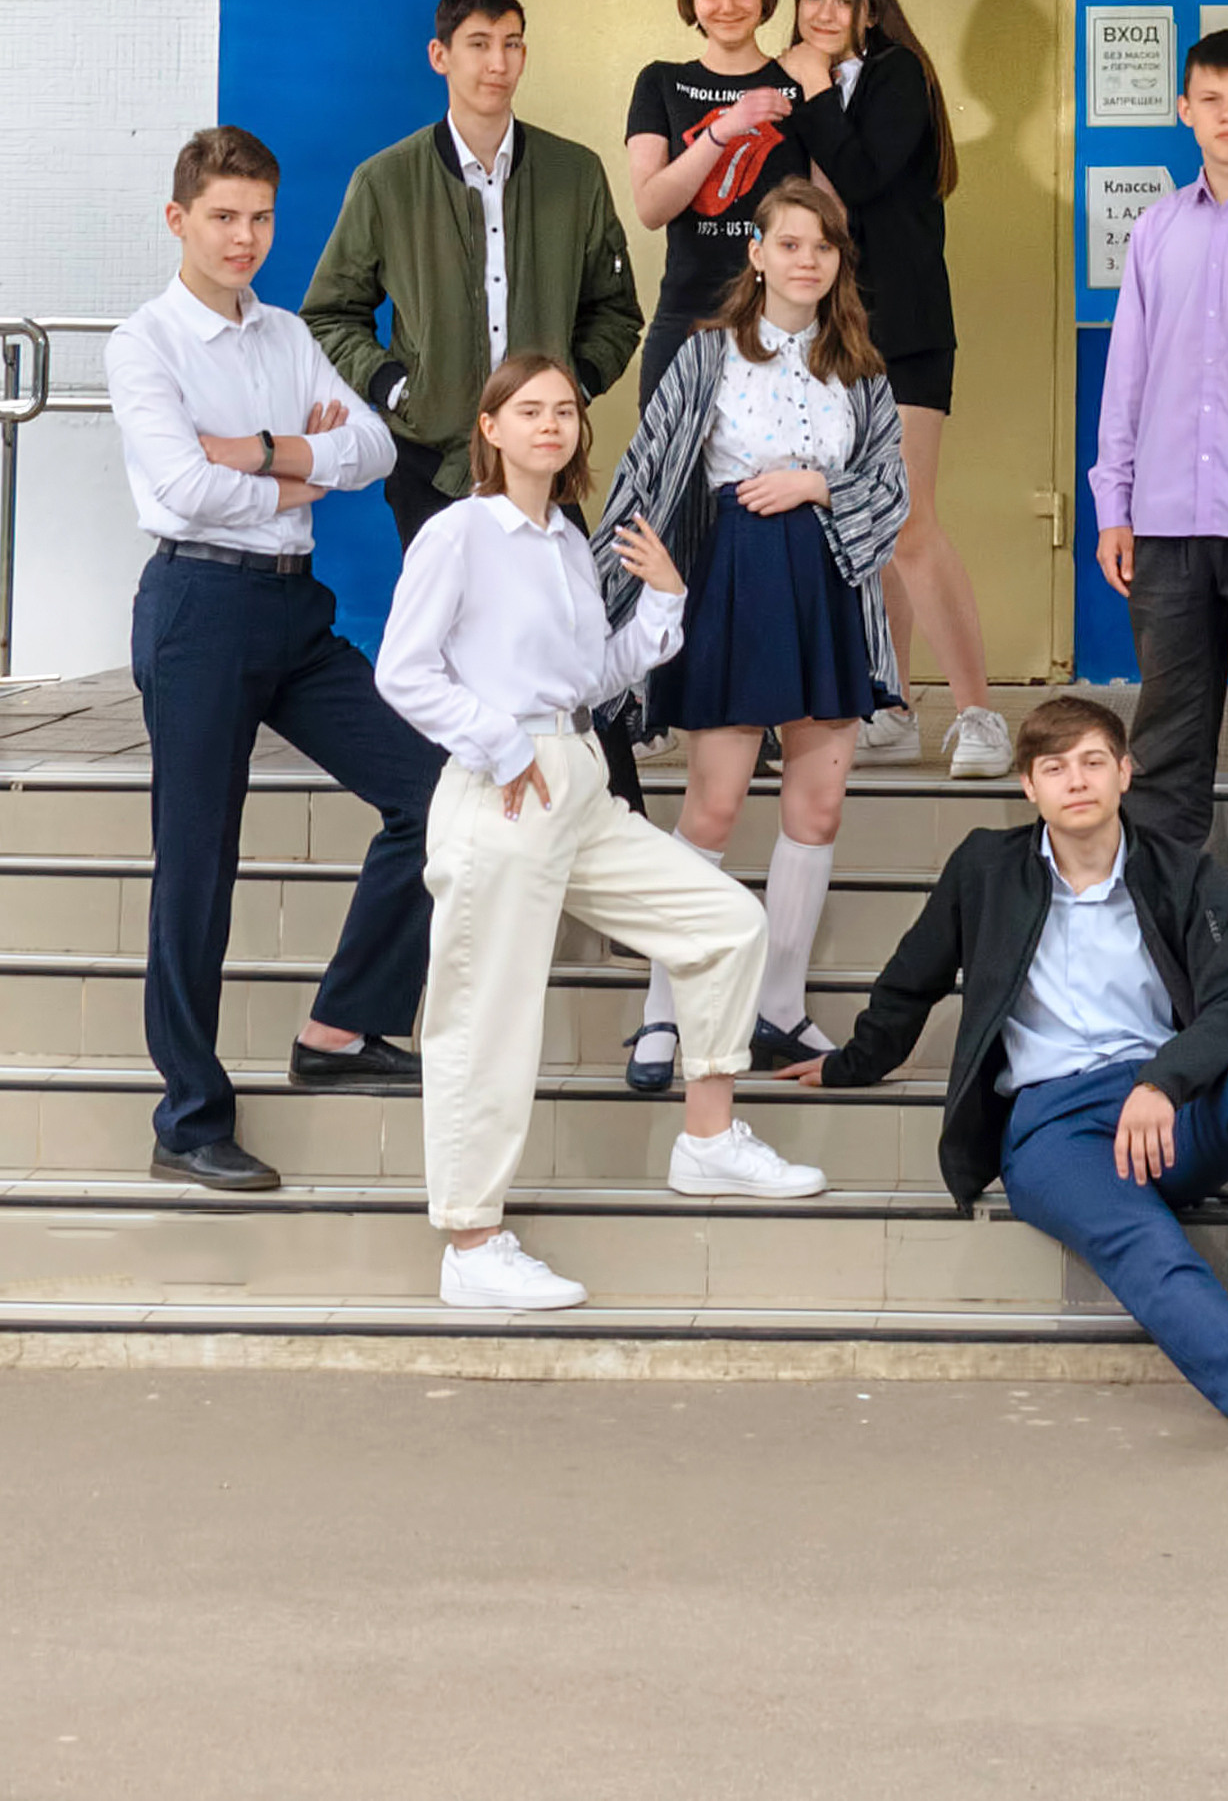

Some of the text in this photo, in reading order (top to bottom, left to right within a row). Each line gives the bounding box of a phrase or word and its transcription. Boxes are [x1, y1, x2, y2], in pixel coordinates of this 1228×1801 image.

[1103, 26, 1160, 45] ВХОД
[1103, 51, 1160, 60] БЕЗ МАСКИ
[1110, 63, 1161, 71] ПЕРЧАТОК
[689, 86, 745, 102] ROLLING
[1103, 97, 1163, 106] ЗАПРЕЩЕН
[1104, 180, 1161, 194] Классы
[1106, 207, 1119, 220] 1.
[726, 221, 741, 236] US
[1106, 232, 1120, 245] 2.
[1106, 257, 1119, 271] 3.
